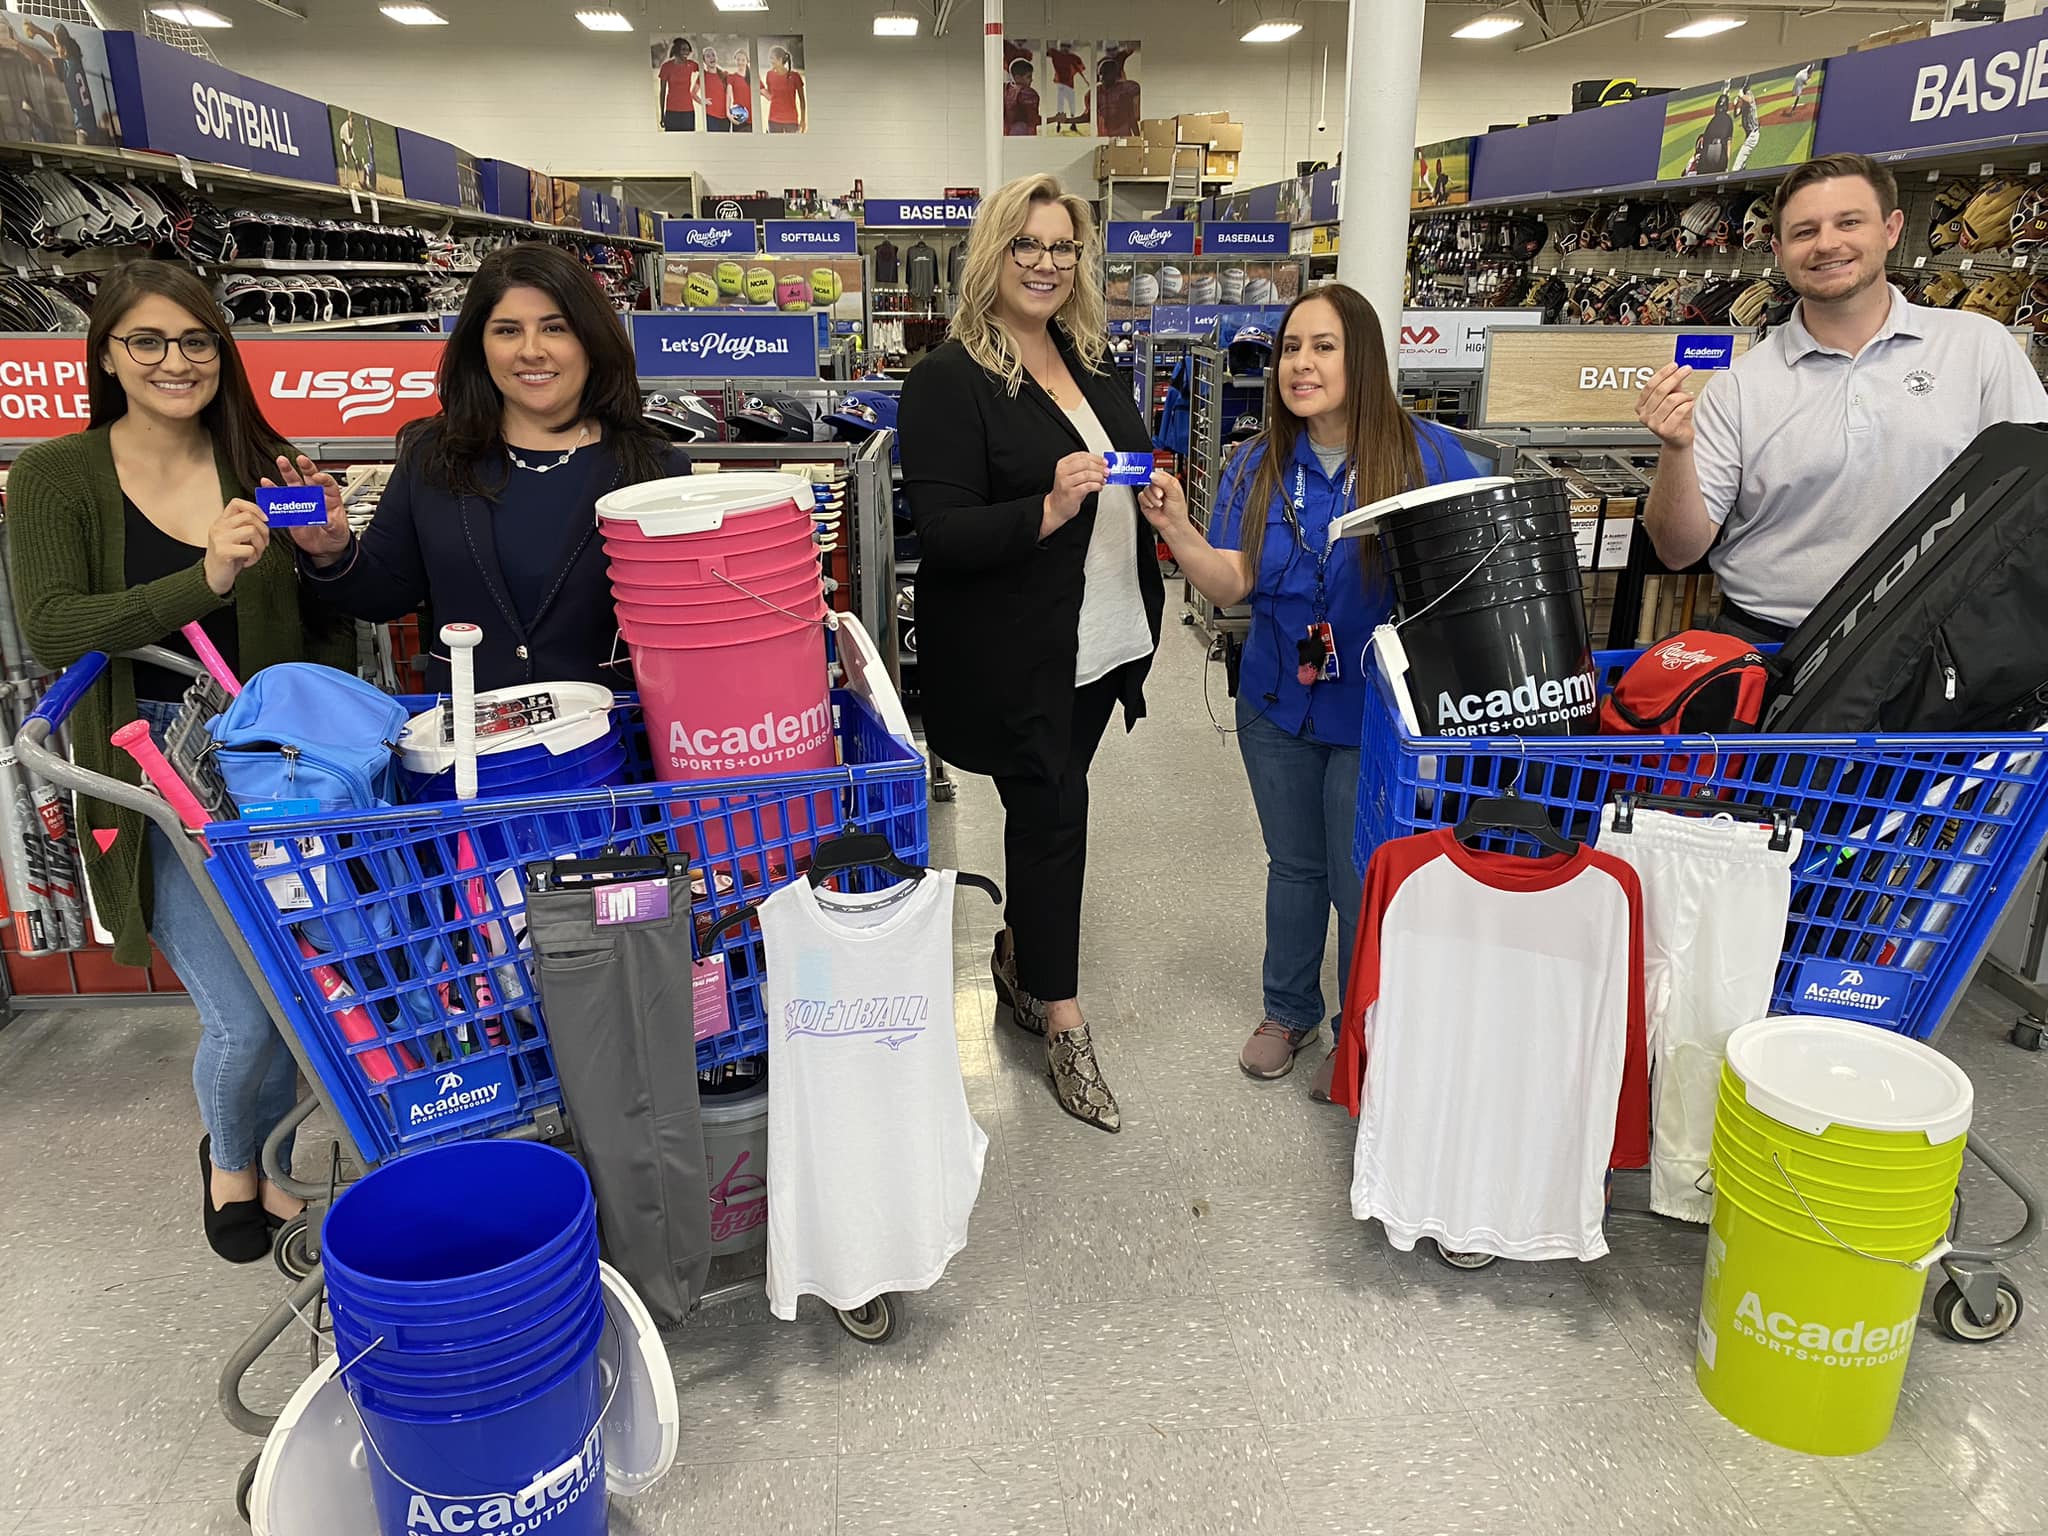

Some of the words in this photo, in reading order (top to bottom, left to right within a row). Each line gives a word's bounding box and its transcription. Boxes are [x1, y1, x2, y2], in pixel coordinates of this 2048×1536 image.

[192, 81, 300, 157] SOFTBALL
[899, 205, 978, 220] BASEBAL
[686, 227, 733, 245] Rawlings
[780, 232, 841, 243] SOFTBALLS
[1128, 228, 1173, 245] Rawlings
[1217, 233, 1275, 243] BASEBALLS
[661, 337, 700, 353] Let's
[700, 332, 756, 361] Play
[755, 338, 789, 353] Ball
[1684, 347, 1726, 358] Academy
[0, 361, 49, 387] CH
[53, 361, 88, 386] PI
[1579, 366, 1655, 390] BATS
[0, 393, 51, 419] OR
[270, 367, 440, 425] USSS
[269, 501, 318, 512] Academy
[1438, 671, 1597, 726] Academy
[669, 692, 832, 757] Academy
[1439, 702, 1594, 738] SPORTS+OUTDOORS
[671, 731, 828, 771] SPORTS+OUTDOORS
[1805, 983, 1887, 1010] Academy
[410, 1083, 498, 1120] Academy
[1735, 1290, 1919, 1354] Academ
[406, 1422, 604, 1534] Academ
